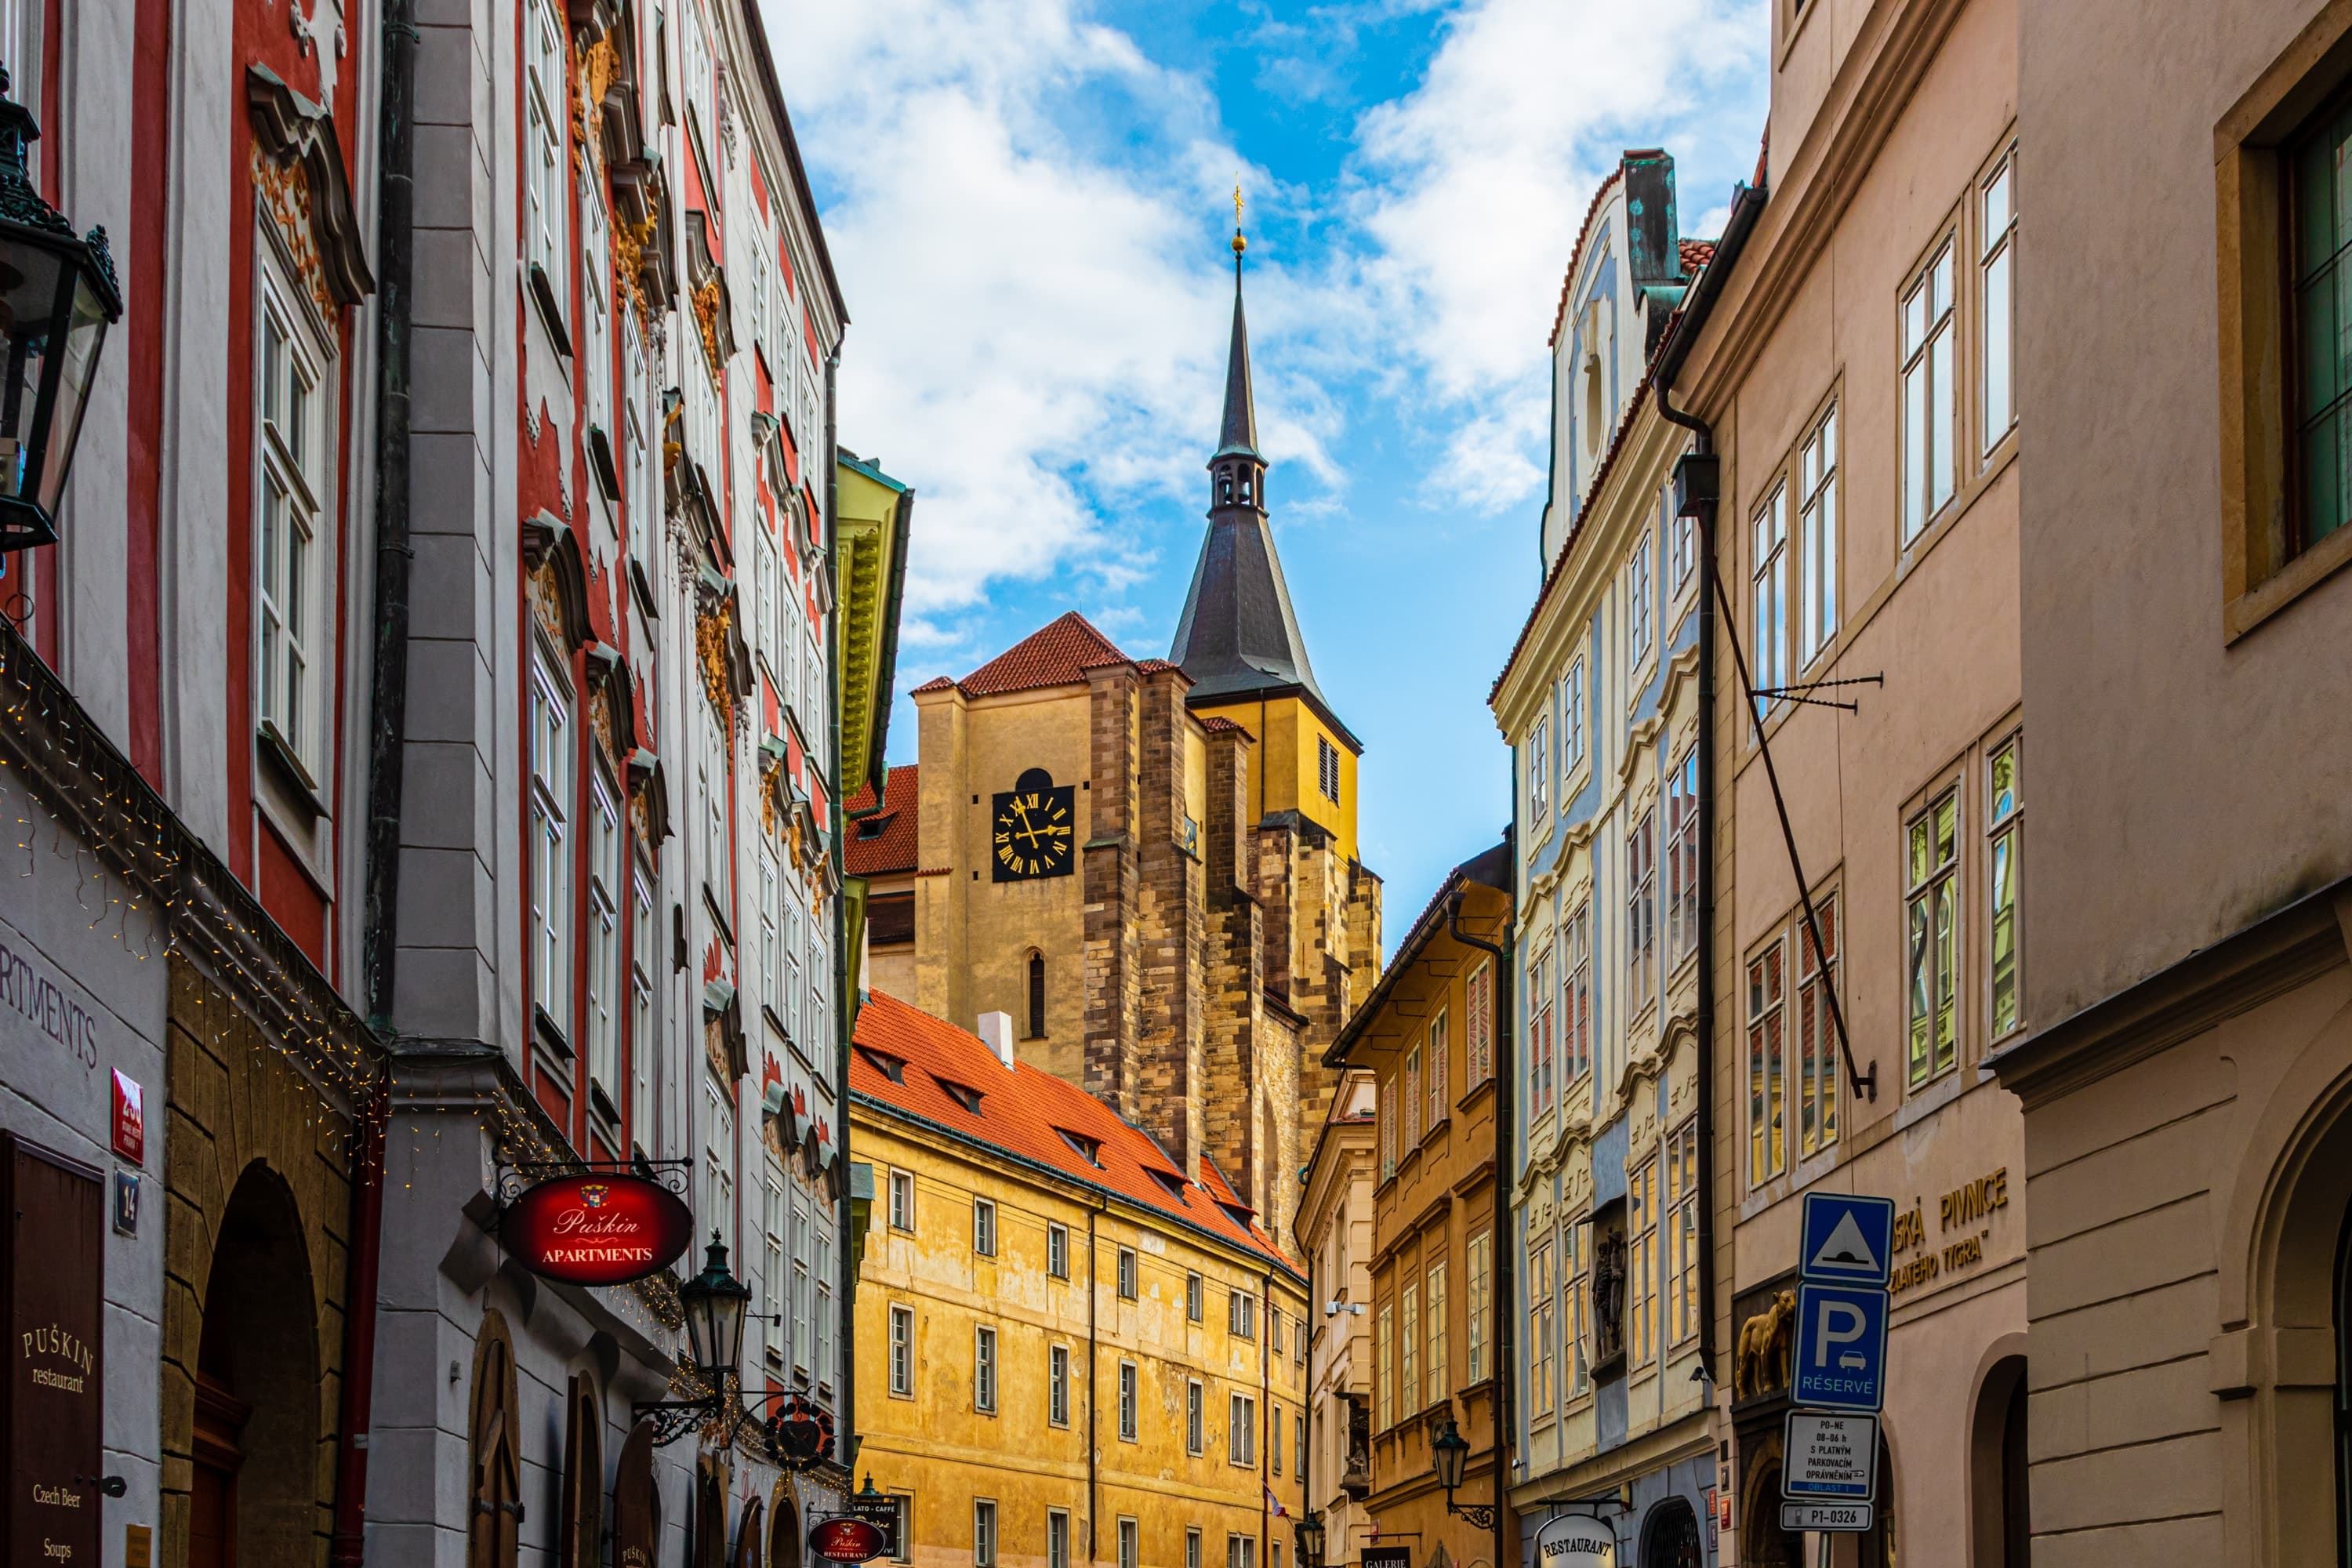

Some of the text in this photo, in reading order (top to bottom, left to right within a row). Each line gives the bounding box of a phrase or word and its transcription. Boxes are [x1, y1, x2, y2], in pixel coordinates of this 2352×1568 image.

[1025, 793, 1039, 809] XII
[999, 813, 1014, 827] X
[1052, 808, 1067, 821] II
[995, 831, 1010, 844] IX
[997, 844, 1015, 865] VIII
[1052, 840, 1067, 856] IV
[1009, 855, 1024, 874] VII
[1029, 858, 1040, 875] VI
[1044, 855, 1056, 869] V
[0, 943, 97, 1070] RTMENTS
[124, 1185, 136, 1221] 14
[1940, 1166, 2009, 1233] PIVNICE
[553, 1208, 640, 1235] Puškin
[543, 1247, 653, 1263] APARTMENTS
[1890, 1251, 1940, 1294] ZLATÉHO
[1815, 1300, 1866, 1367] P
[22, 1323, 94, 1377] PUŠKIN
[32, 1367, 84, 1394] restaurant
[1802, 1374, 1874, 1395] RÉSERVÉ
[1820, 1421, 1845, 1430] PO-NE
[1817, 1433, 1847, 1443] 08-06 h
[1810, 1446, 1851, 1456] S PLATNÝM
[1808, 1457, 1853, 1468] PARKOVACÍM
[1806, 1469, 1853, 1481] OPRÁVNĚNÍM
[1808, 1483, 1842, 1492] OBLAST
[33, 1483, 82, 1509] Czech Beer
[1811, 1510, 1857, 1523] P1-0326
[44, 1537, 72, 1565] Soups
[622, 1544, 647, 1566] PUŠKIN
[823, 1551, 868, 1559] RESTAURANT
[1544, 1537, 1612, 1559] RESTAURANT
[1366, 1559, 1406, 1568] GALERIE
